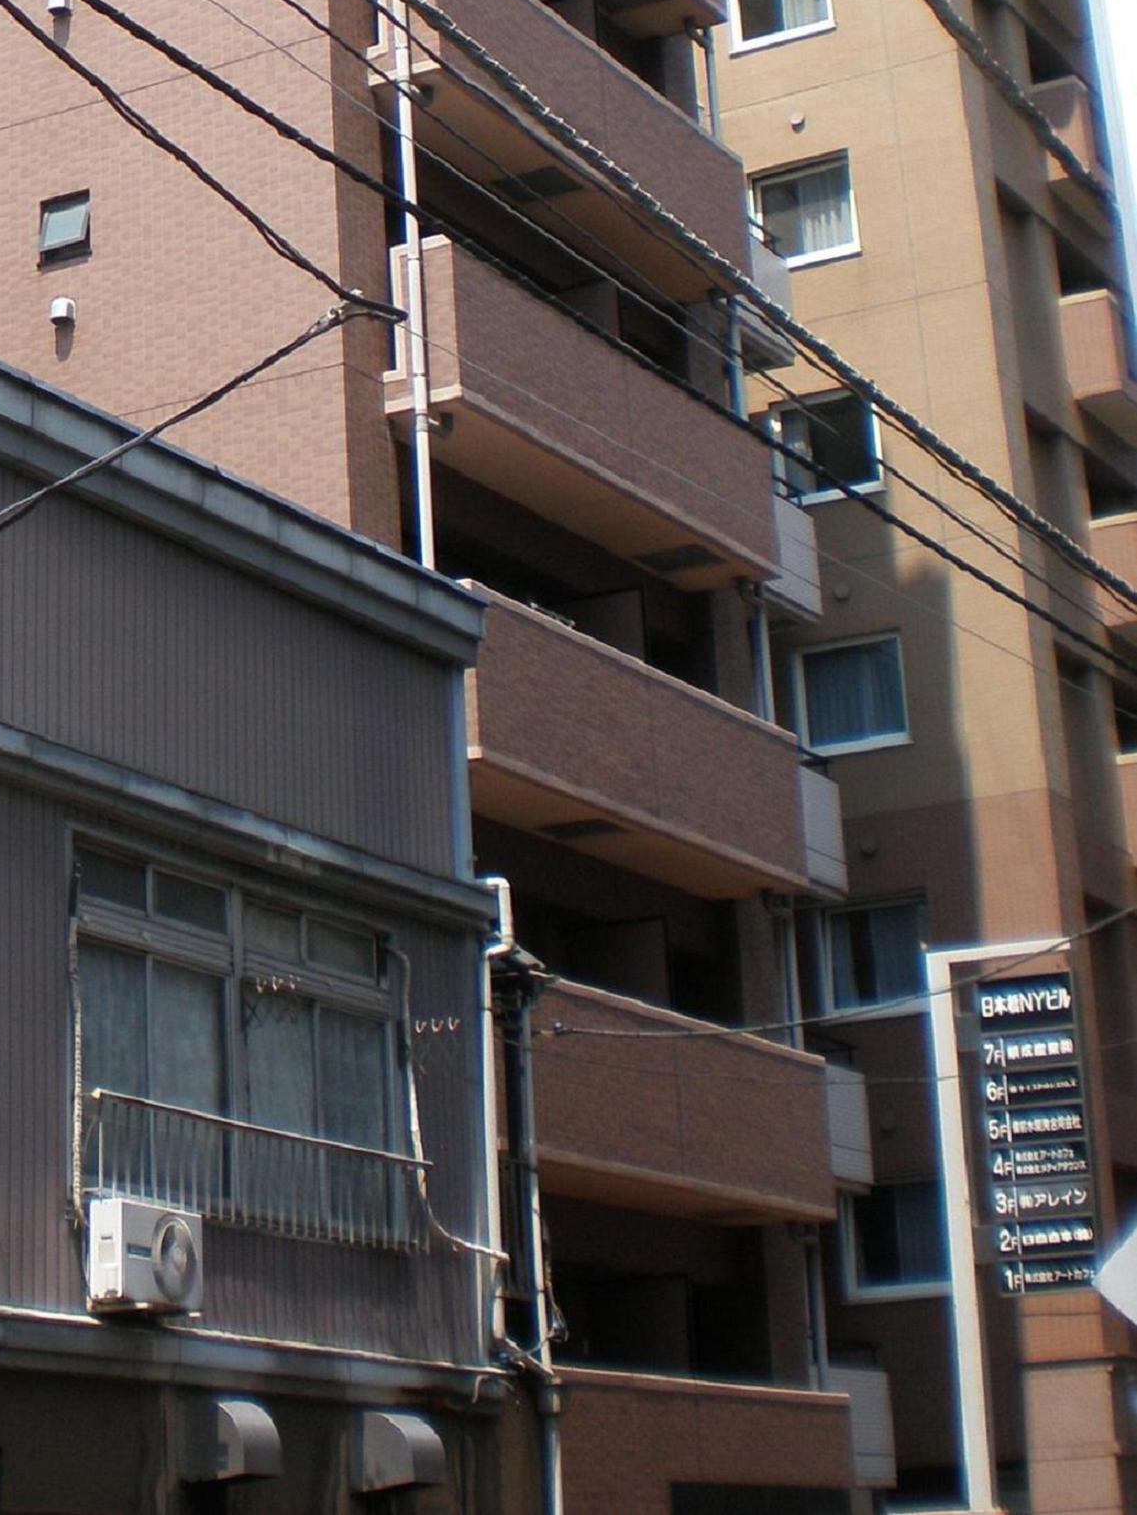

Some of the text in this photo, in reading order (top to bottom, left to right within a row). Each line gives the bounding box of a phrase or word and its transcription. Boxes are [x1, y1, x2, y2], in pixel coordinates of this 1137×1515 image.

[983, 1043, 1003, 1065] 7F
[986, 1081, 1004, 1102] 6F
[988, 1119, 1007, 1140] 5F
[992, 1153, 1013, 1177] 4F
[995, 1192, 1014, 1214] 3F
[999, 1228, 1019, 1252] 2F
[1004, 1268, 1022, 1291] 1F
